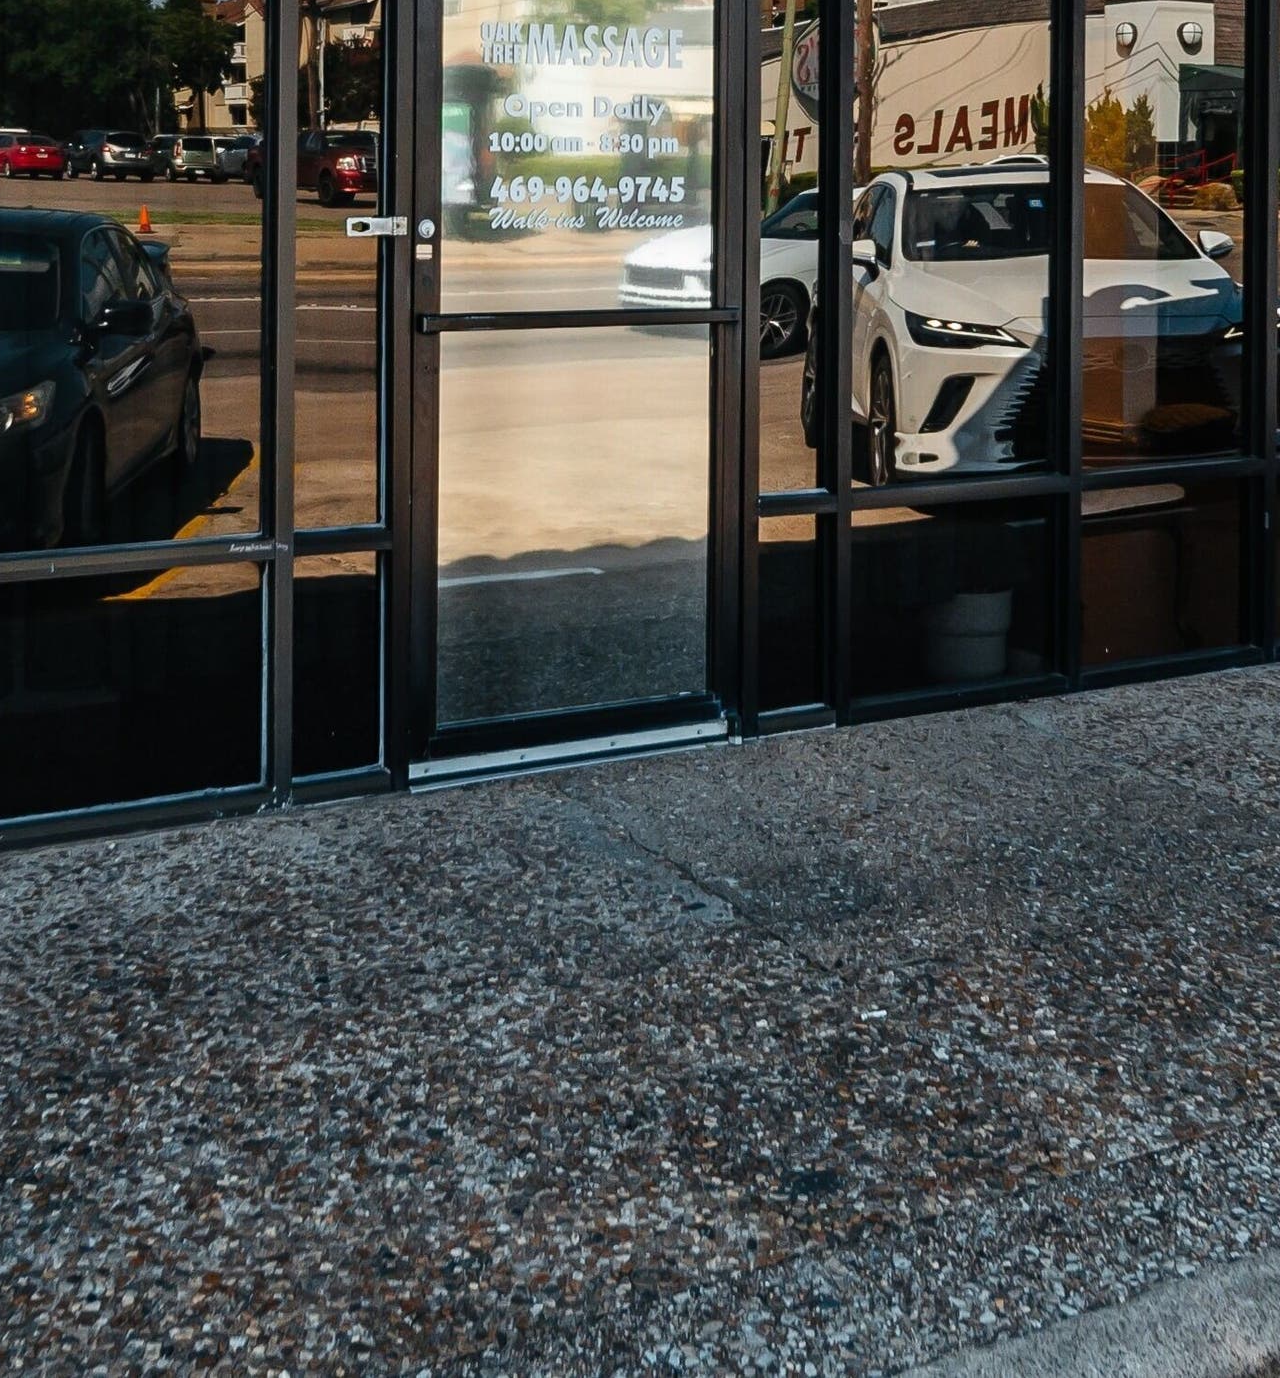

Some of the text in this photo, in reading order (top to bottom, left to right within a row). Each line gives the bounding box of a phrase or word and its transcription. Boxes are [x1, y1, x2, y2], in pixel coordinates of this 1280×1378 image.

[481, 22, 522, 42] OAK
[482, 43, 524, 64] TREE
[526, 23, 683, 69] MASSAGE
[504, 93, 666, 126] Open Daily
[489, 132, 546, 153] 10:00
[551, 137, 583, 153] am
[599, 133, 644, 154] 8:30
[648, 136, 679, 159] pm
[490, 175, 685, 203] 469-964-9745
[489, 206, 684, 229] Walk-ins Welcome
